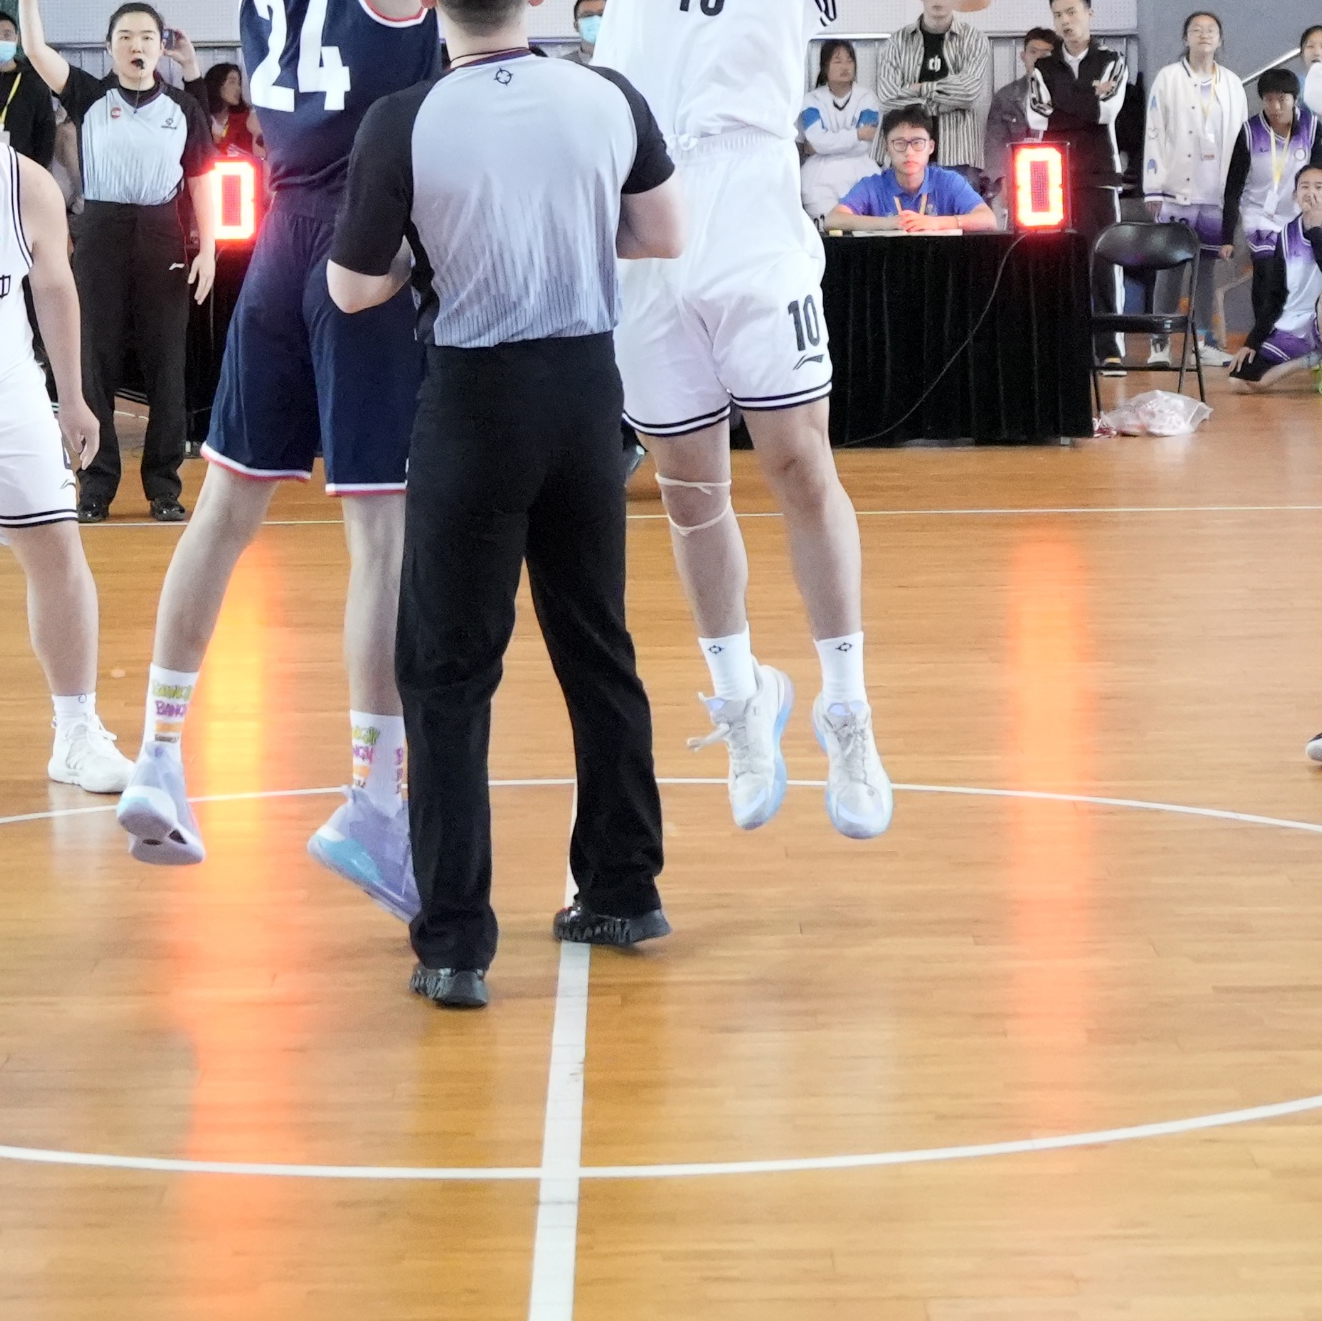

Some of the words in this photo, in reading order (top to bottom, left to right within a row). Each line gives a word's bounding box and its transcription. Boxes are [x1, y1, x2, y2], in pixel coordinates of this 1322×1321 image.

[211, 161, 255, 240] 0
[1015, 146, 1066, 228] 0
[787, 294, 821, 352] 10
